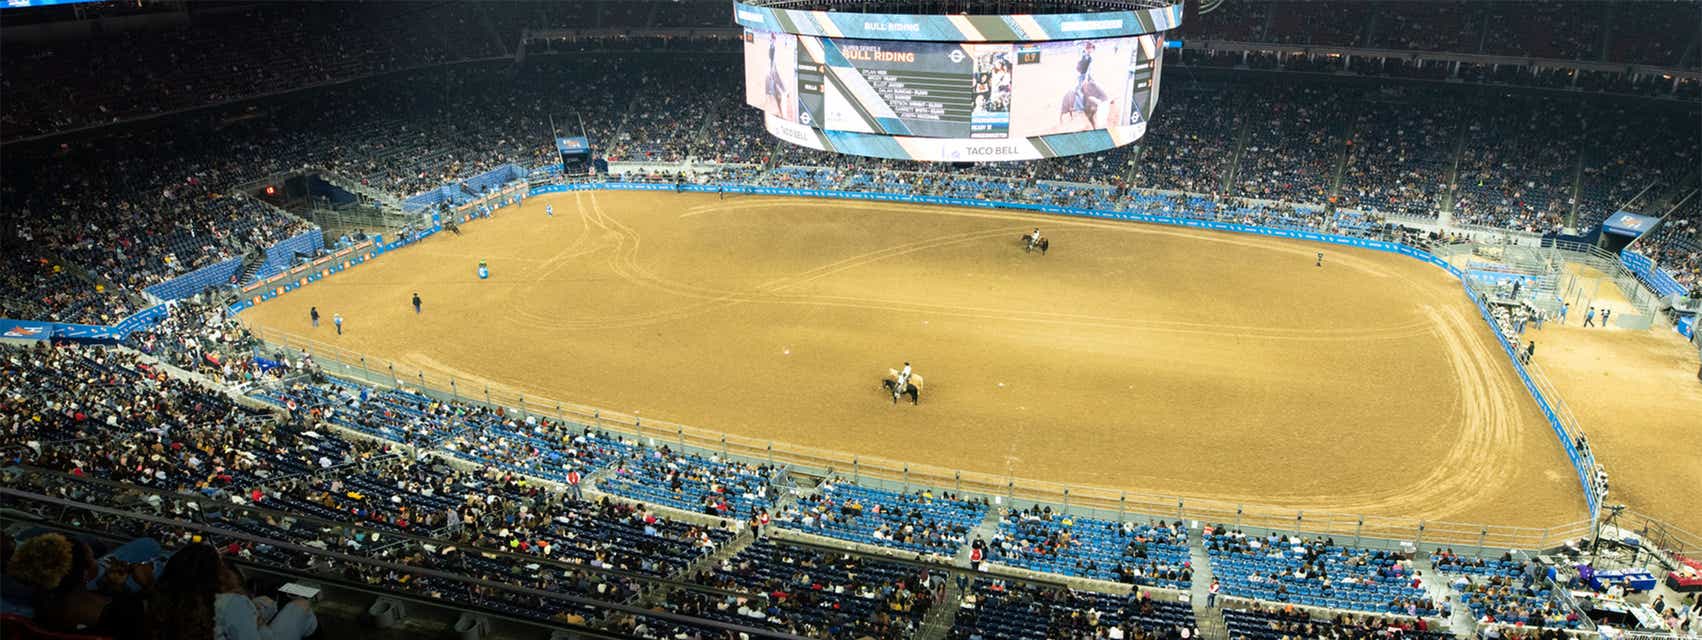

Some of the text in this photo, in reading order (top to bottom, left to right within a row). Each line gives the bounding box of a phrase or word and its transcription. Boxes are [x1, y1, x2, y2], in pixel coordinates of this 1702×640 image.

[844, 50, 915, 63] BULL RIDING
[966, 146, 1019, 156] TACO BELL
